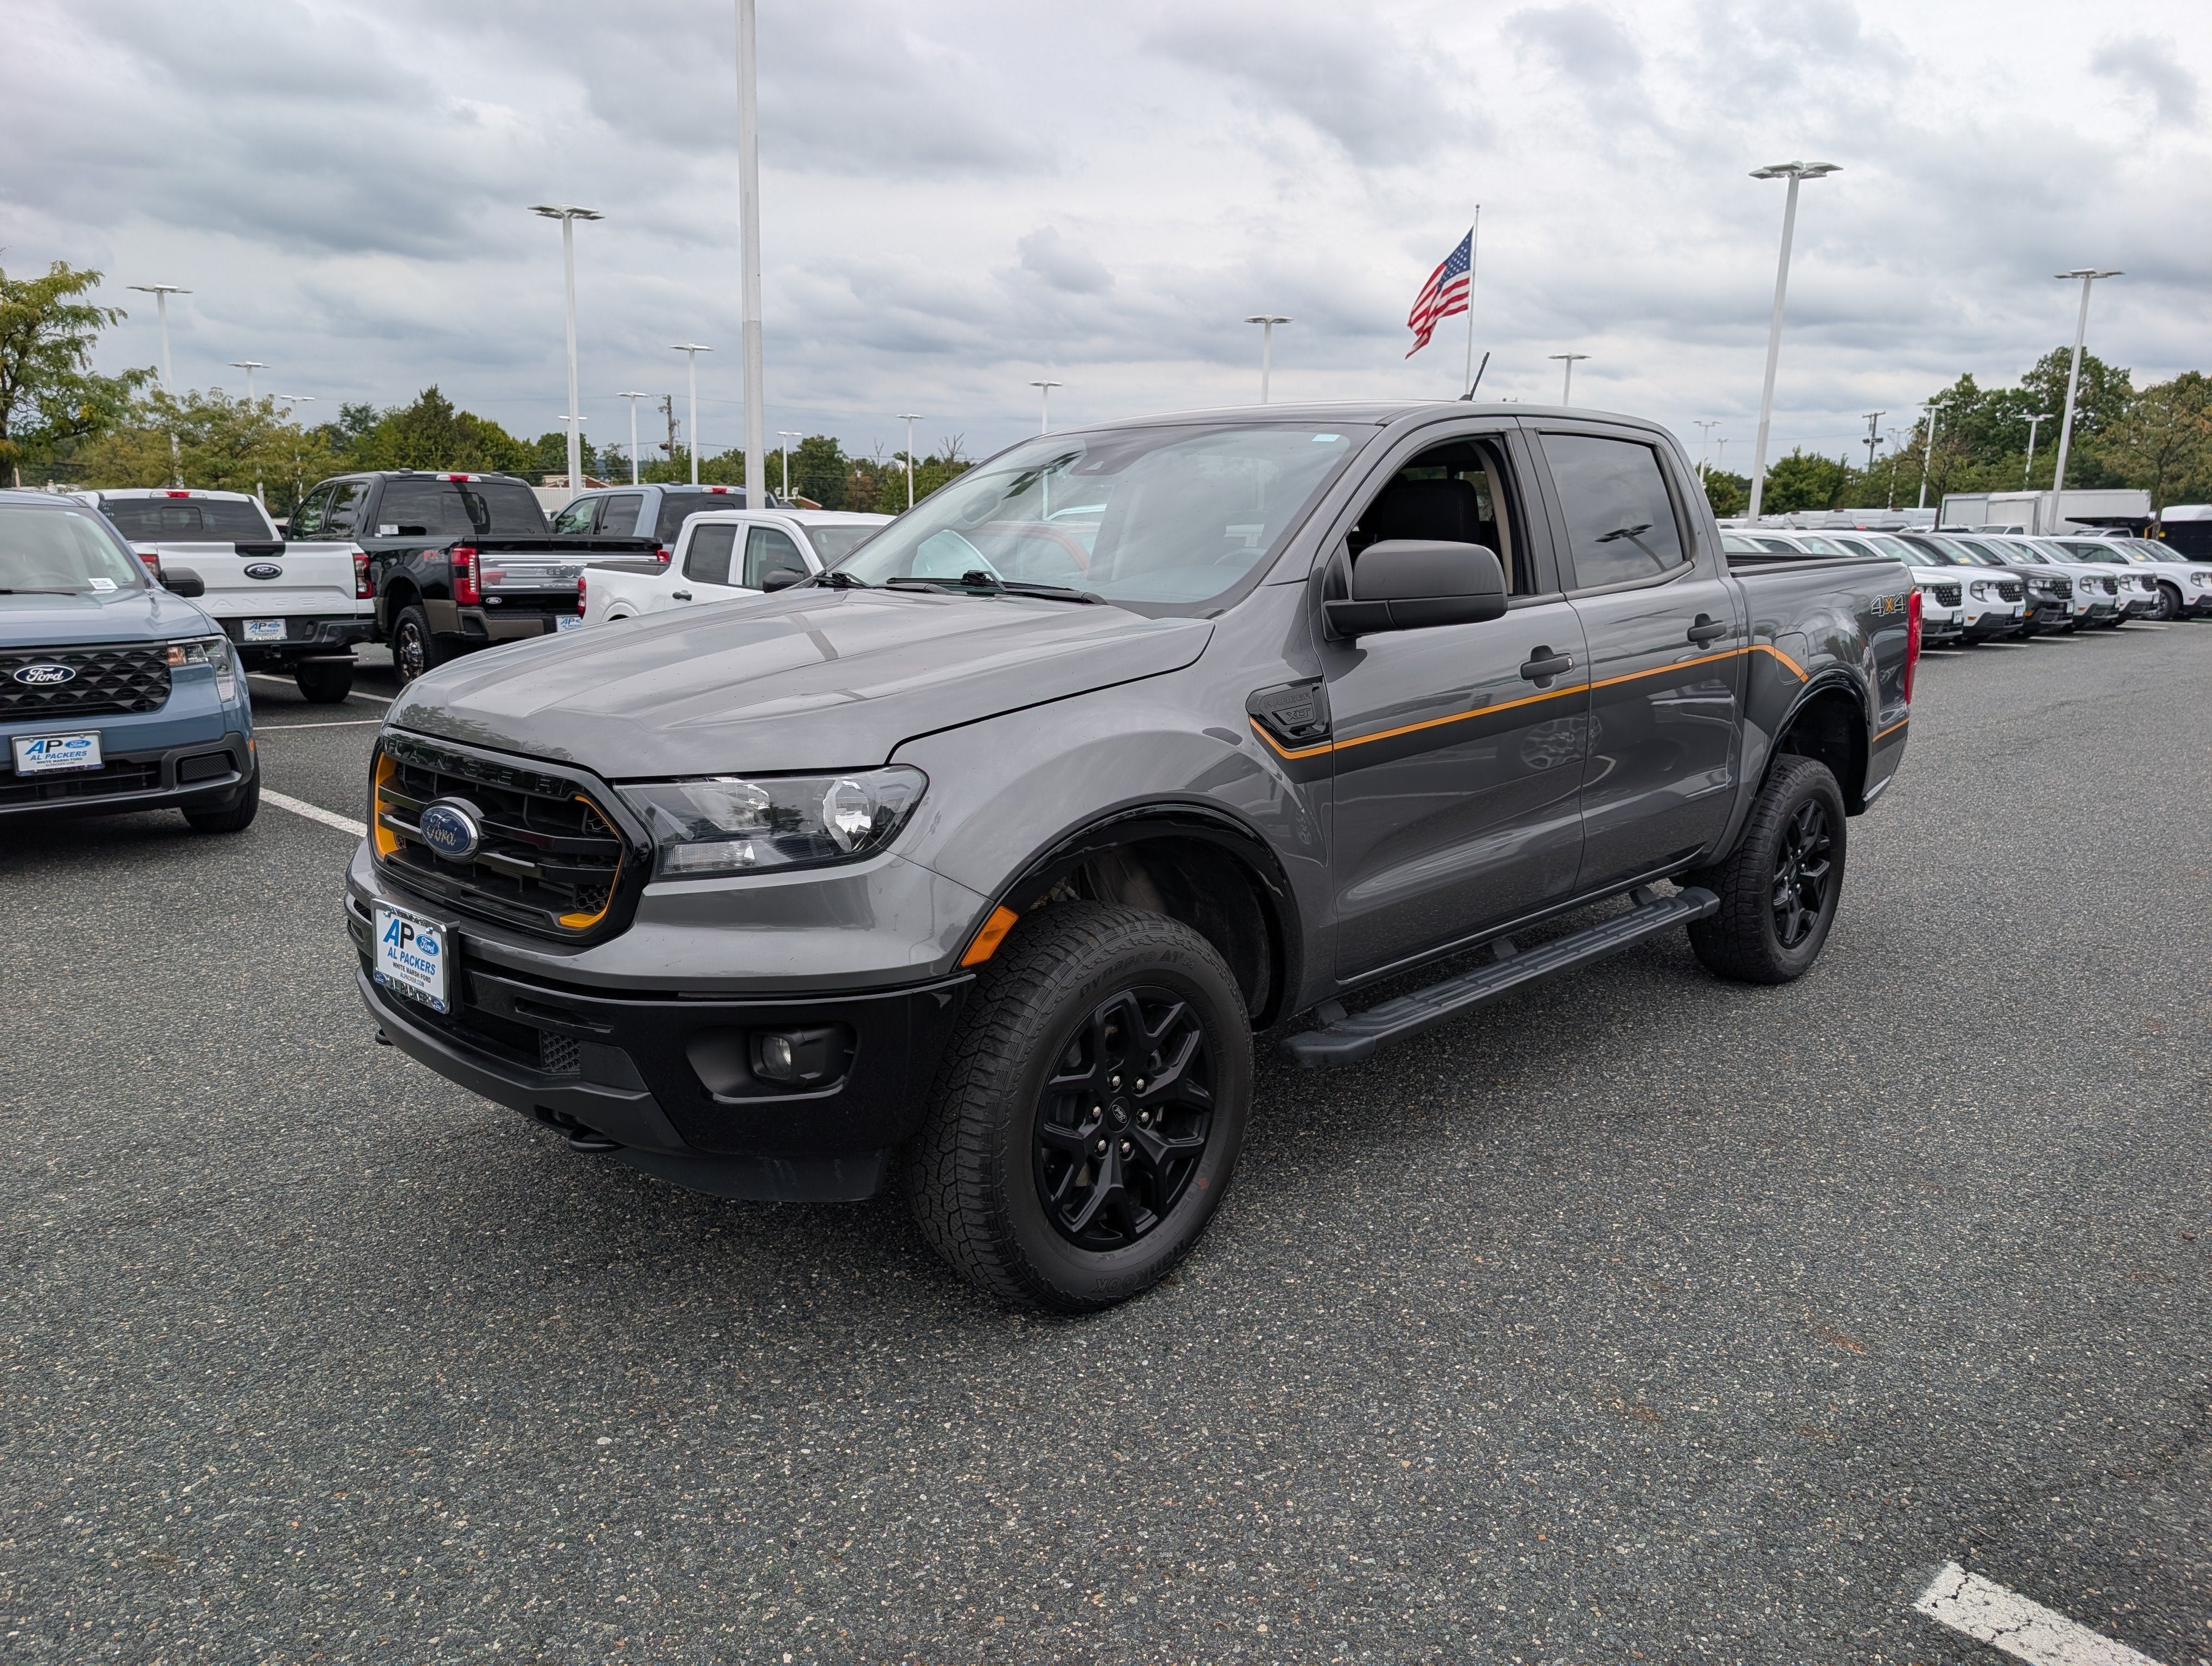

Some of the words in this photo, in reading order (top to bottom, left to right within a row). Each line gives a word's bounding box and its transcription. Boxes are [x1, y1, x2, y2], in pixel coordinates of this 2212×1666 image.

[249, 622, 267, 630] AP
[27, 668, 65, 682] Ford
[1263, 693, 1311, 709] RANGER
[1285, 707, 1311, 721] XLT
[24, 740, 63, 755] AP
[45, 750, 88, 760] PACKERS
[385, 740, 553, 794] RANGER
[427, 813, 458, 846] Ford
[383, 918, 415, 950] AP
[420, 934, 435, 954] Ford
[387, 946, 398, 960] AL
[400, 950, 436, 976] PACKERS
[393, 962, 406, 972] WHITE
[406, 966, 420, 979] MARSH
[420, 973, 431, 984] FORD
[400, 972, 425, 988] ALPACKER.COM
[390, 978, 400, 990] AL
